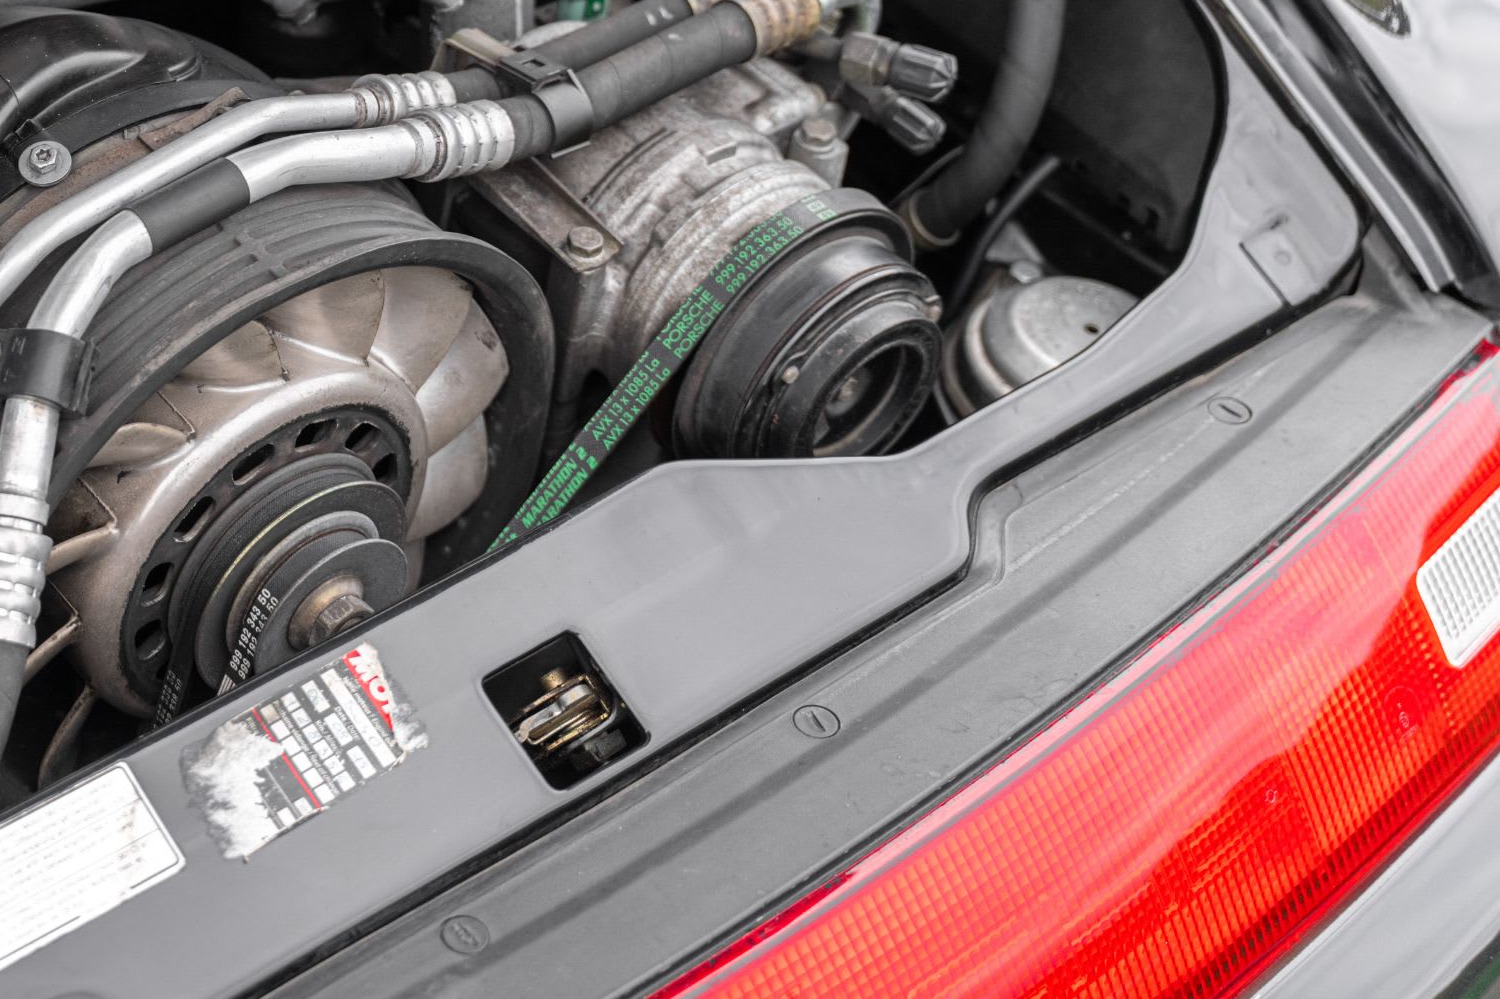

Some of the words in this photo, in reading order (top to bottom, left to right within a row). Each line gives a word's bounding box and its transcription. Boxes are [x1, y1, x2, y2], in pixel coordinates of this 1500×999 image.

[522, 458, 578, 528] MARATHON
[576, 446, 587, 460] 2
[592, 416, 612, 440] AVX
[609, 403, 622, 416] 13
[625, 371, 648, 395] 1085
[662, 291, 712, 349] PORSCHE
[538, 469, 588, 525] ARATHON
[586, 456, 597, 470] 2
[604, 424, 622, 450] AVX
[622, 411, 634, 425] 13
[636, 379, 659, 405] 1085
[675, 302, 724, 360] PORSCHE
[230, 649, 244, 671] 999
[239, 628, 251, 648] 192
[247, 605, 261, 628] 343
[257, 588, 271, 605] 50
[236, 658, 250, 679] 999
